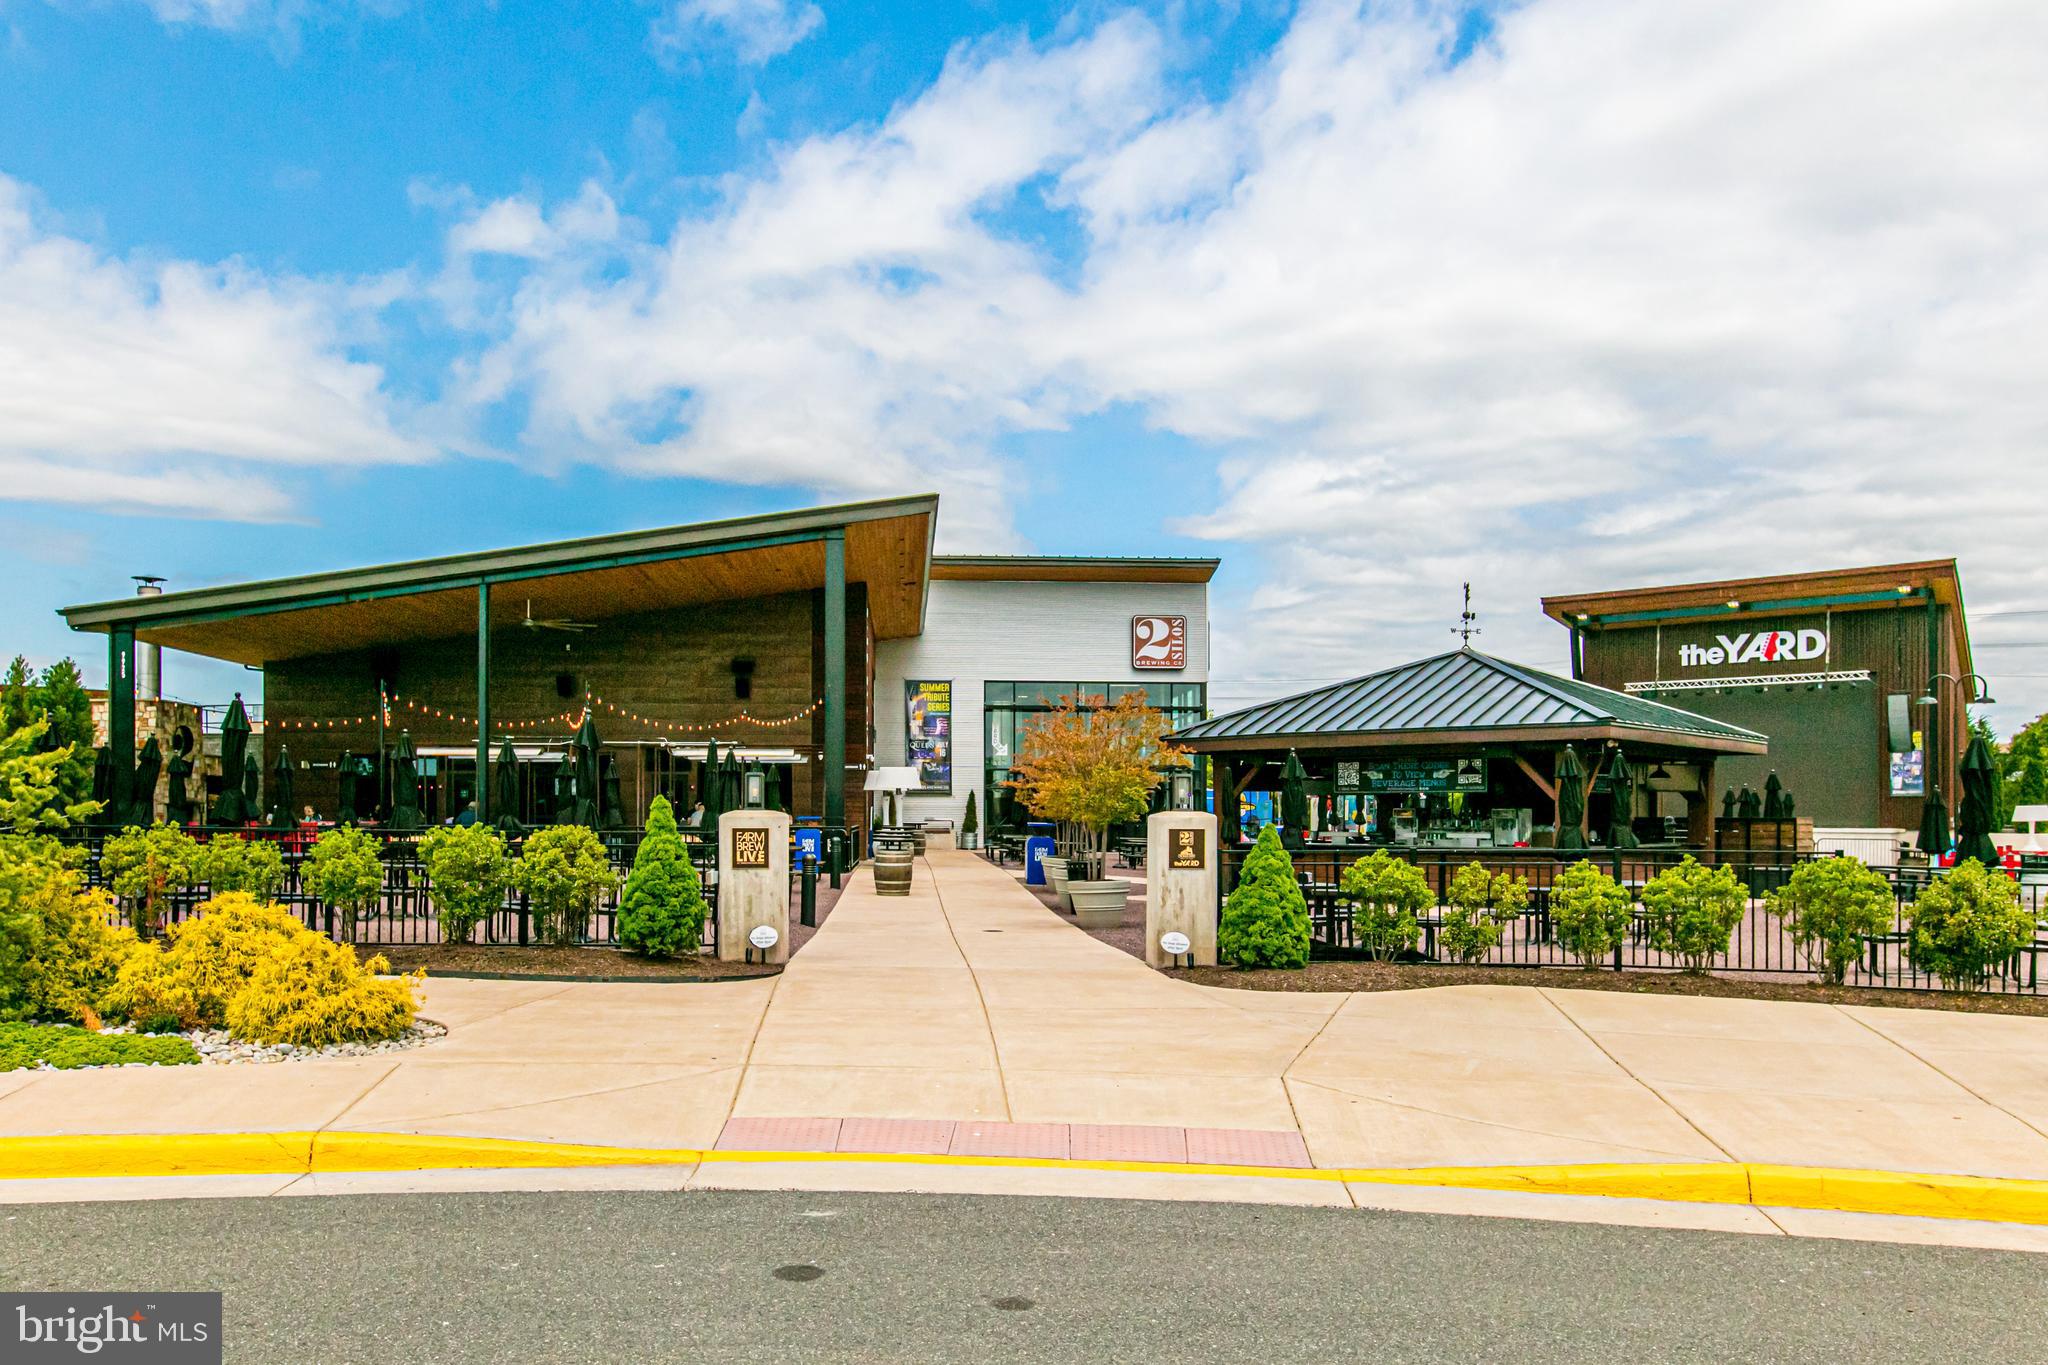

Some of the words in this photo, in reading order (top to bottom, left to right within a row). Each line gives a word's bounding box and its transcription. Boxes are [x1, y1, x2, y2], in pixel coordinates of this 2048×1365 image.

[1136, 618, 1171, 660] 2
[1171, 619, 1184, 660] SILOS
[920, 683, 950, 692] SUMMER
[924, 693, 950, 702] TRIBUTE
[927, 702, 950, 712] SERIES
[1372, 780, 1416, 788] BEVERAGE
[736, 832, 765, 842] FARM
[736, 841, 765, 851] BREW
[736, 850, 765, 862] LIVE
